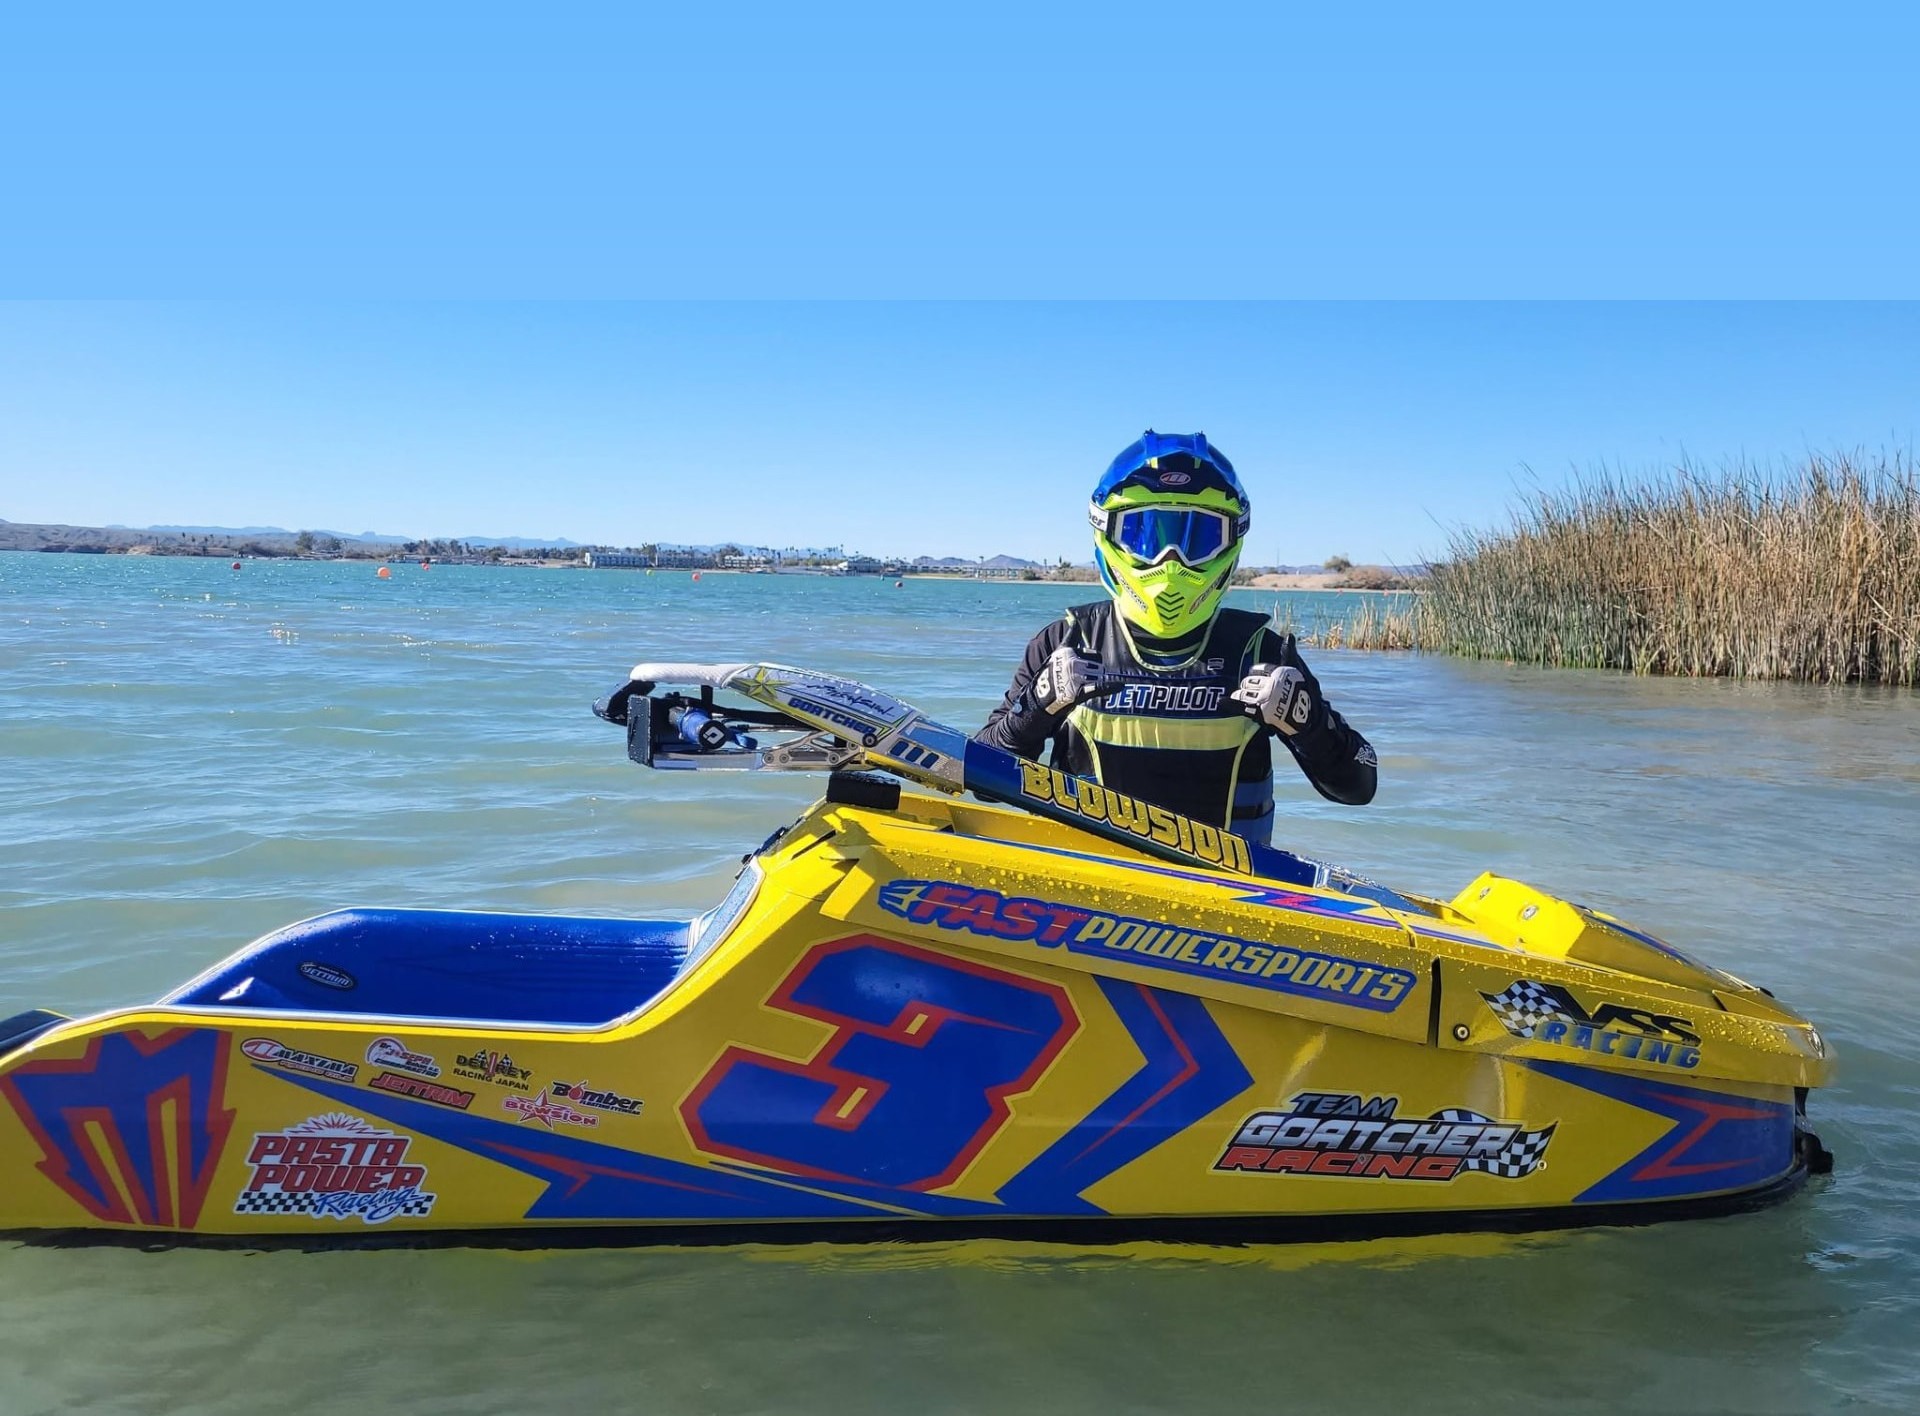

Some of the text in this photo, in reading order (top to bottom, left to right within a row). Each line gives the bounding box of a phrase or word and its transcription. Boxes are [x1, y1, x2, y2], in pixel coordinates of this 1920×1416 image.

[1105, 684, 1225, 711] JETPILOT
[788, 697, 877, 734] GOATCHER
[1019, 758, 1254, 876] BLOWSION
[908, 883, 1413, 1001] FAST POWERSPORTS
[677, 931, 1083, 1193] 3
[1543, 1021, 1701, 1069] RACING
[369, 1073, 476, 1109] JETTRIM
[453, 1067, 529, 1091] RACING JAPAN
[552, 1080, 644, 1110] Bomber
[1296, 1094, 1397, 1119] TEAM
[248, 1135, 410, 1166] PASTA
[1234, 1115, 1522, 1159] GOATCHER
[248, 1164, 425, 1194] POWER
[1218, 1146, 1461, 1178] RACING
[316, 1186, 425, 1220] Racing
